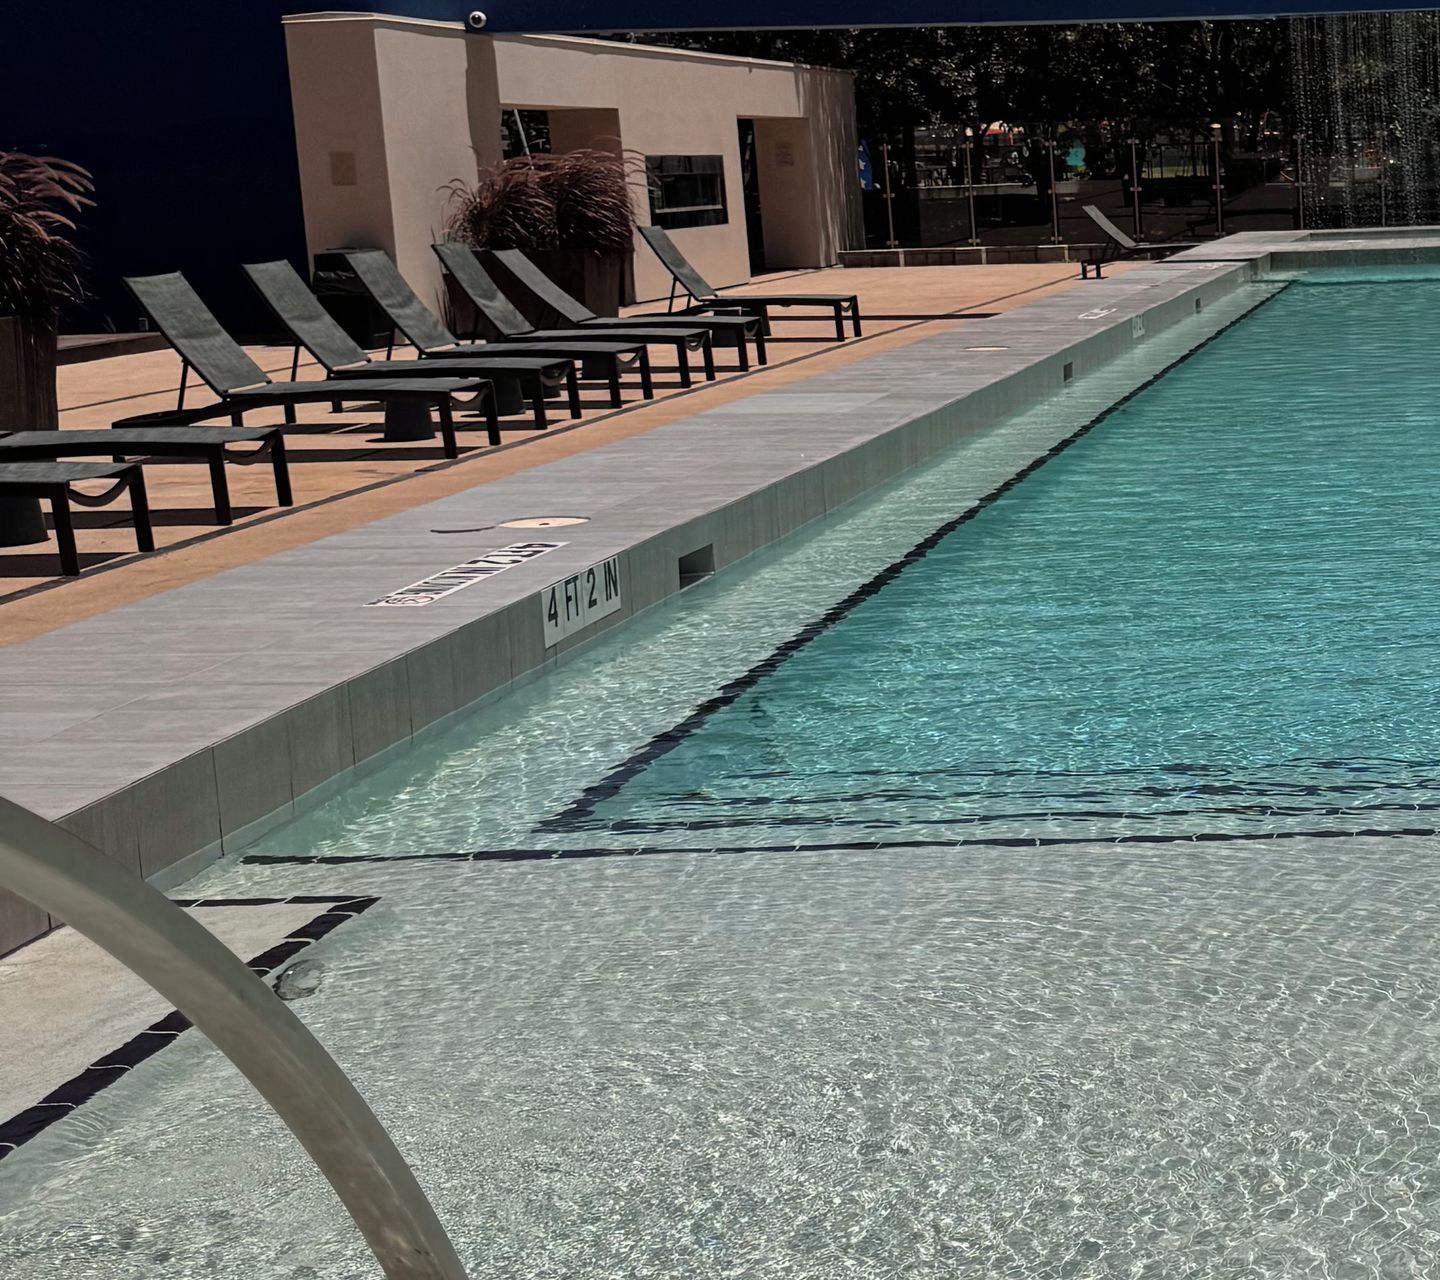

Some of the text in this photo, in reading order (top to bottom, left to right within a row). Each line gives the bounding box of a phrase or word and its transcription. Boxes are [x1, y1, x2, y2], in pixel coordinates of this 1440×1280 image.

[547, 556, 618, 628] 4 FT 2 IN
